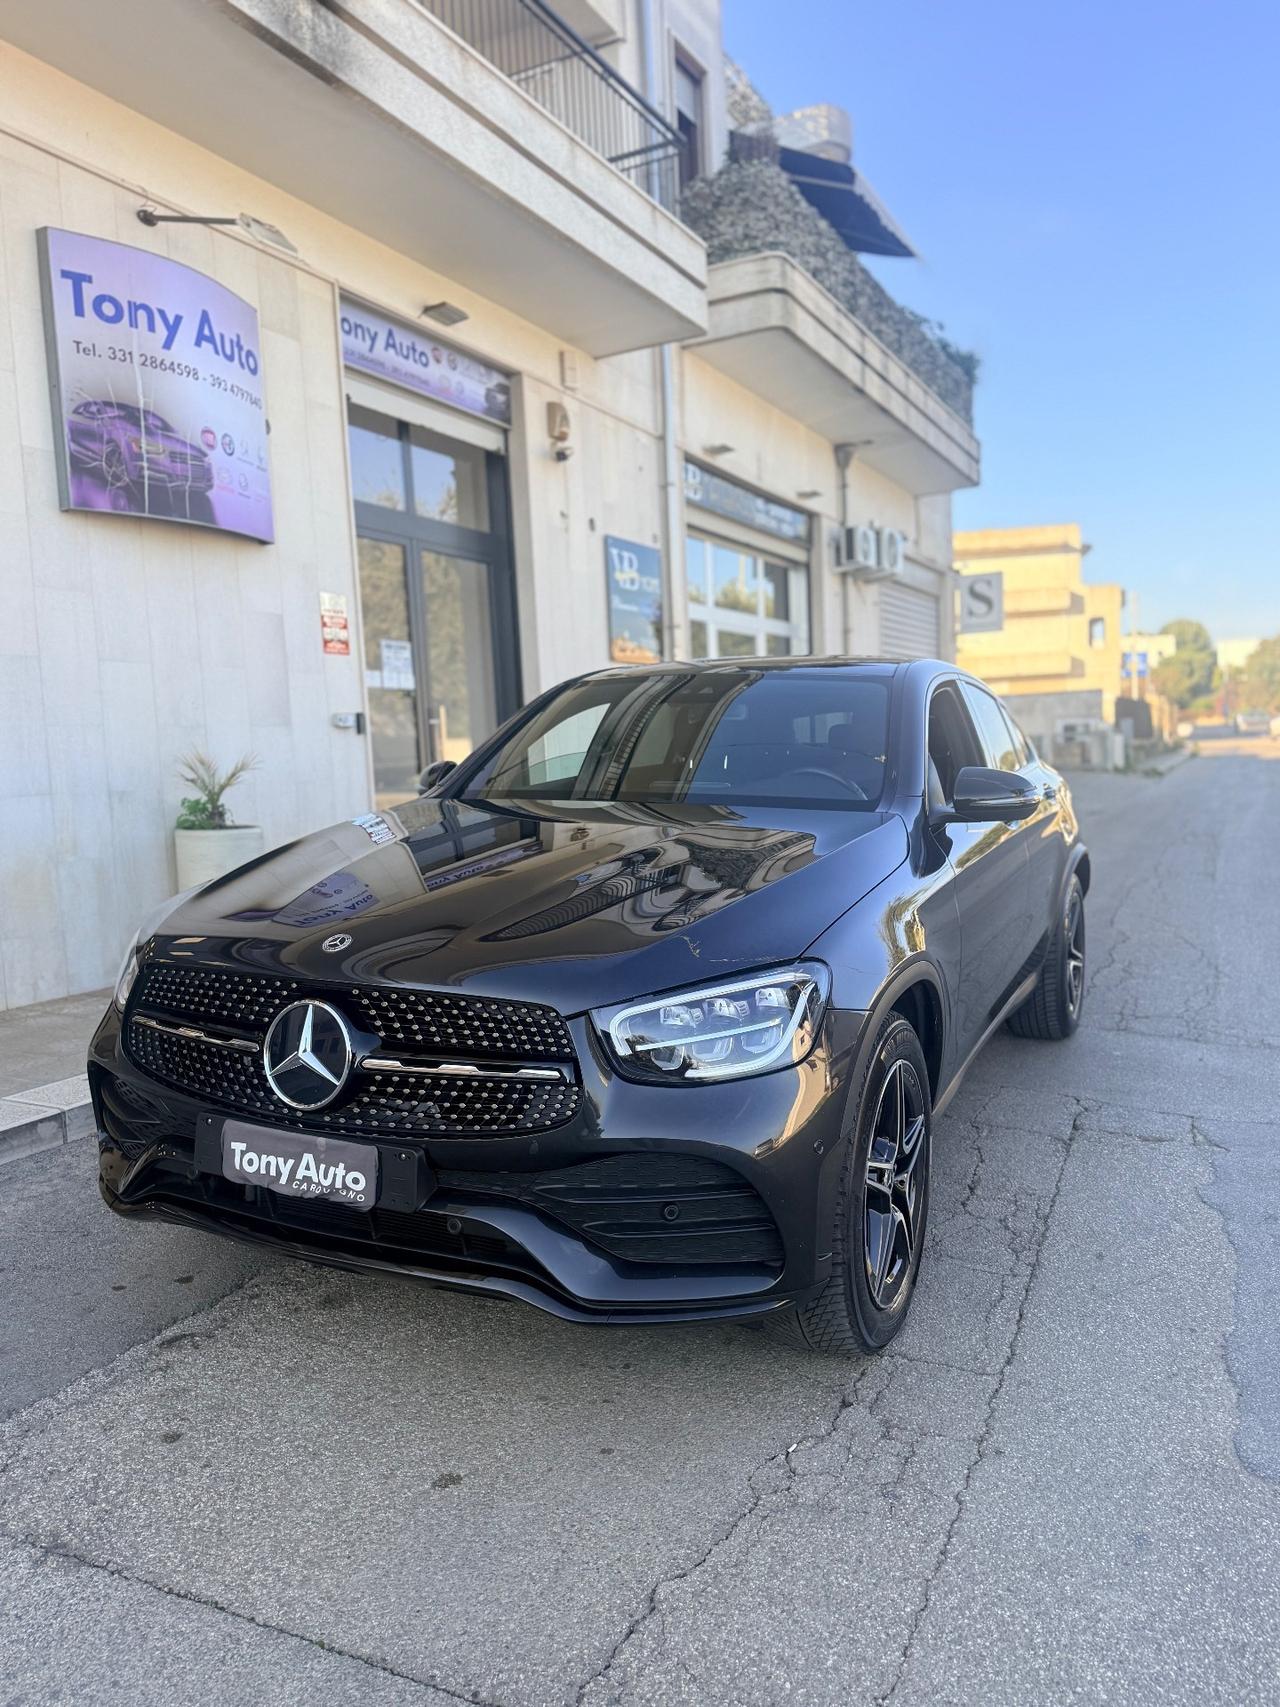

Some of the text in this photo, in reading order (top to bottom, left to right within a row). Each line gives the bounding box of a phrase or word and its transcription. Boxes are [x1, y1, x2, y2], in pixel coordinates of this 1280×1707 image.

[60, 269, 183, 351] Tony
[194, 308, 259, 377] Auto
[72, 340, 103, 359] Tel.
[107, 346, 134, 365] 331
[139, 352, 200, 382] 2864598
[384, 327, 431, 368] Auto
[967, 576, 995, 620] S
[230, 1141, 366, 1192] Tony Auto
[292, 1180, 366, 1202] CAROVGNO
